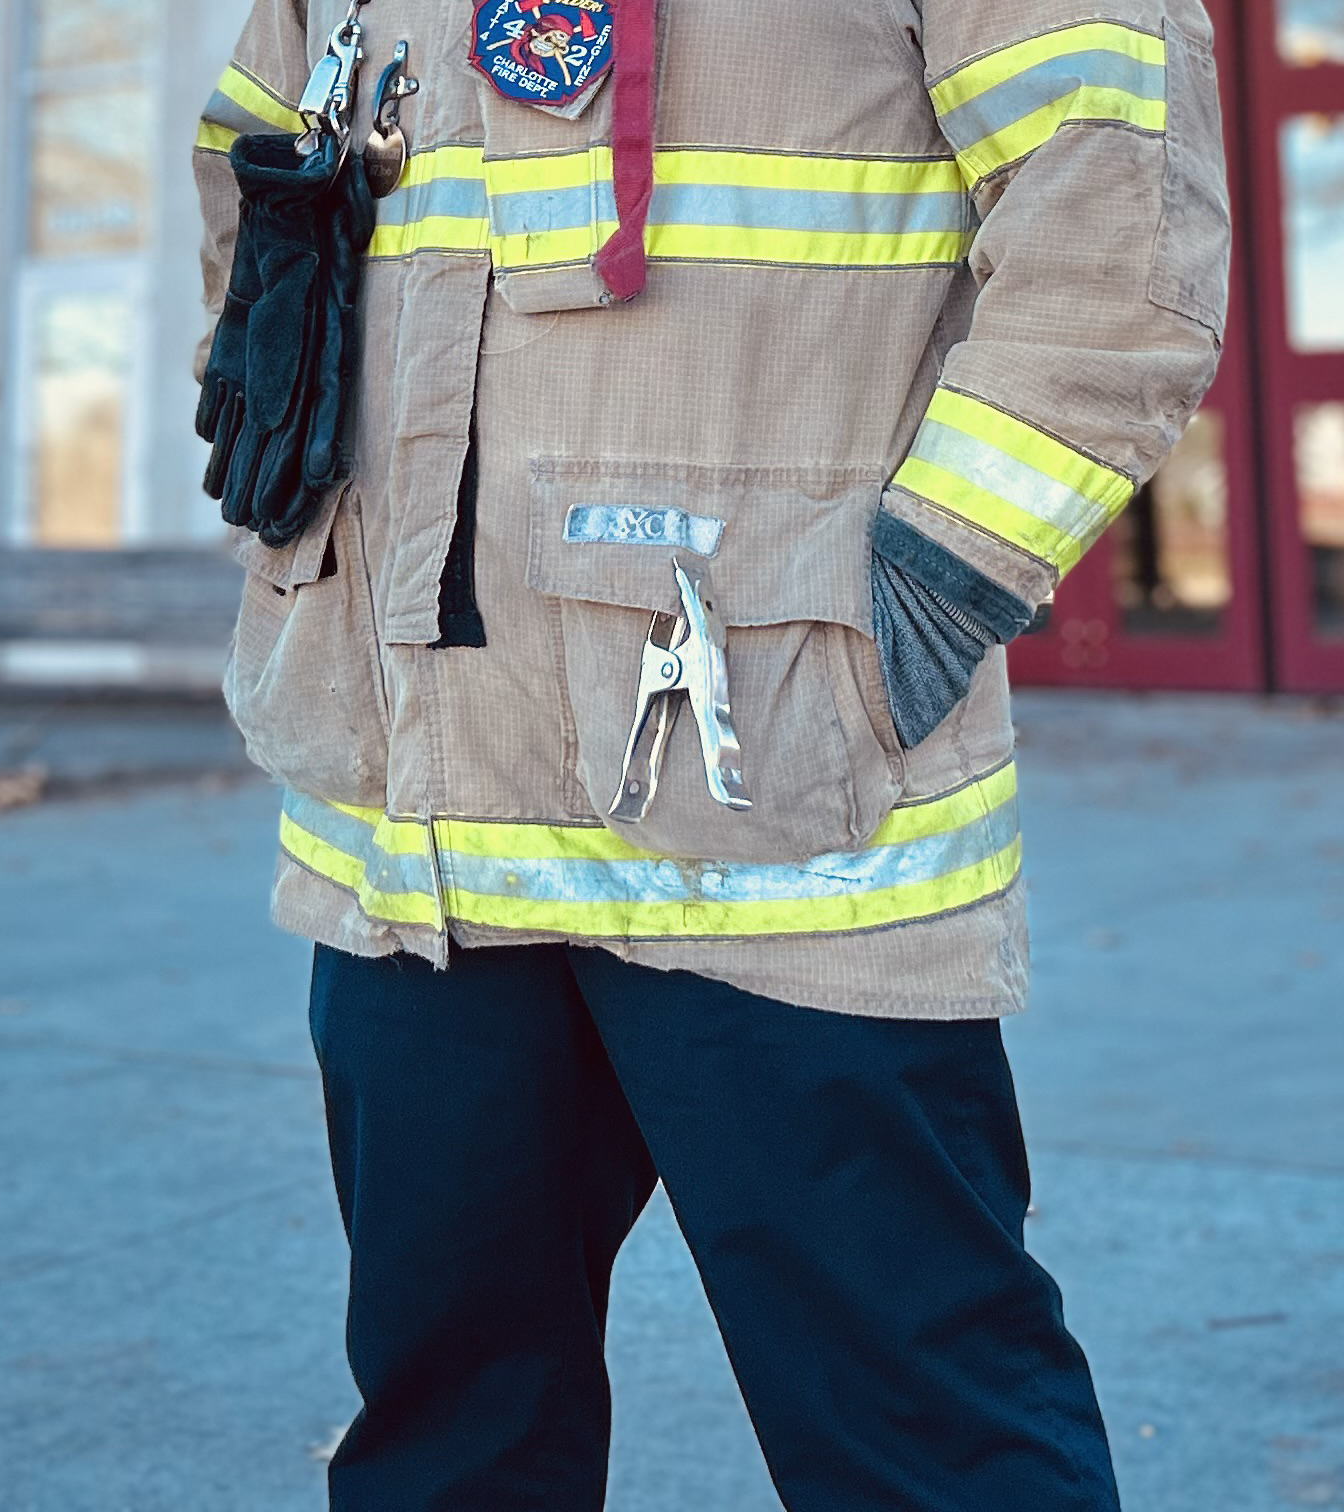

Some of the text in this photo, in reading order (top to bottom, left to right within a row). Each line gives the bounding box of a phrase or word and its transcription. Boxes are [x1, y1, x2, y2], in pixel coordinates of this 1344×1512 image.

[491, 65, 519, 83] FIRE
[493, 55, 559, 92] CHARLOTTE
[573, 24, 612, 88] ENGINE
